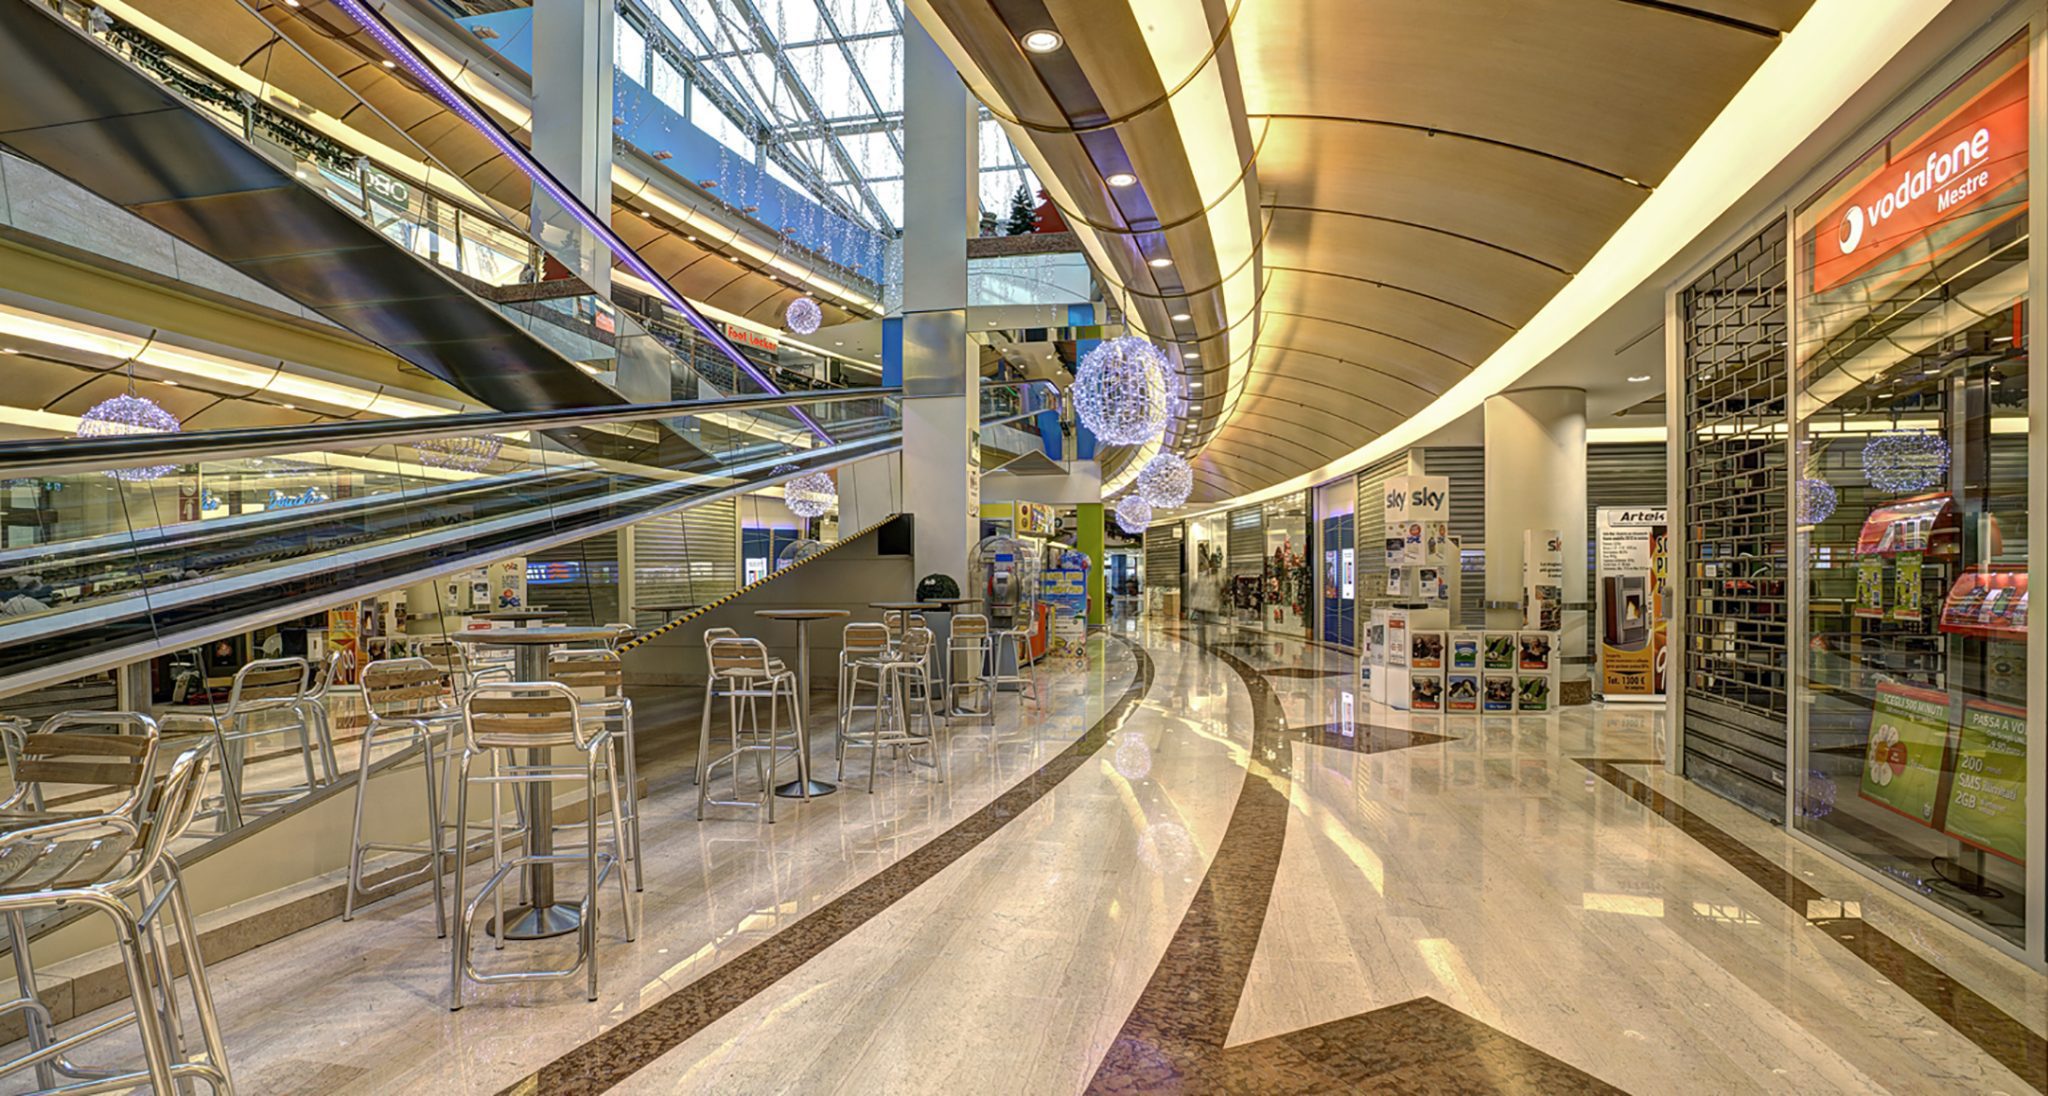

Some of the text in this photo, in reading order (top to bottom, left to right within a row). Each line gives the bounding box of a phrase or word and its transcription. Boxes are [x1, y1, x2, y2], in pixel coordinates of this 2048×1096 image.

[1868, 128, 1989, 227] vodafone
[1938, 171, 1989, 213] Mestre
[727, 325, 777, 352] Foot Locker
[1386, 489, 1406, 512] sky
[1412, 487, 1445, 511] sky
[1973, 713, 2025, 734] PASSA A VO
[1961, 754, 1983, 772] 200
[1959, 773, 1981, 791] SMS
[1955, 791, 1977, 809] 2GB
